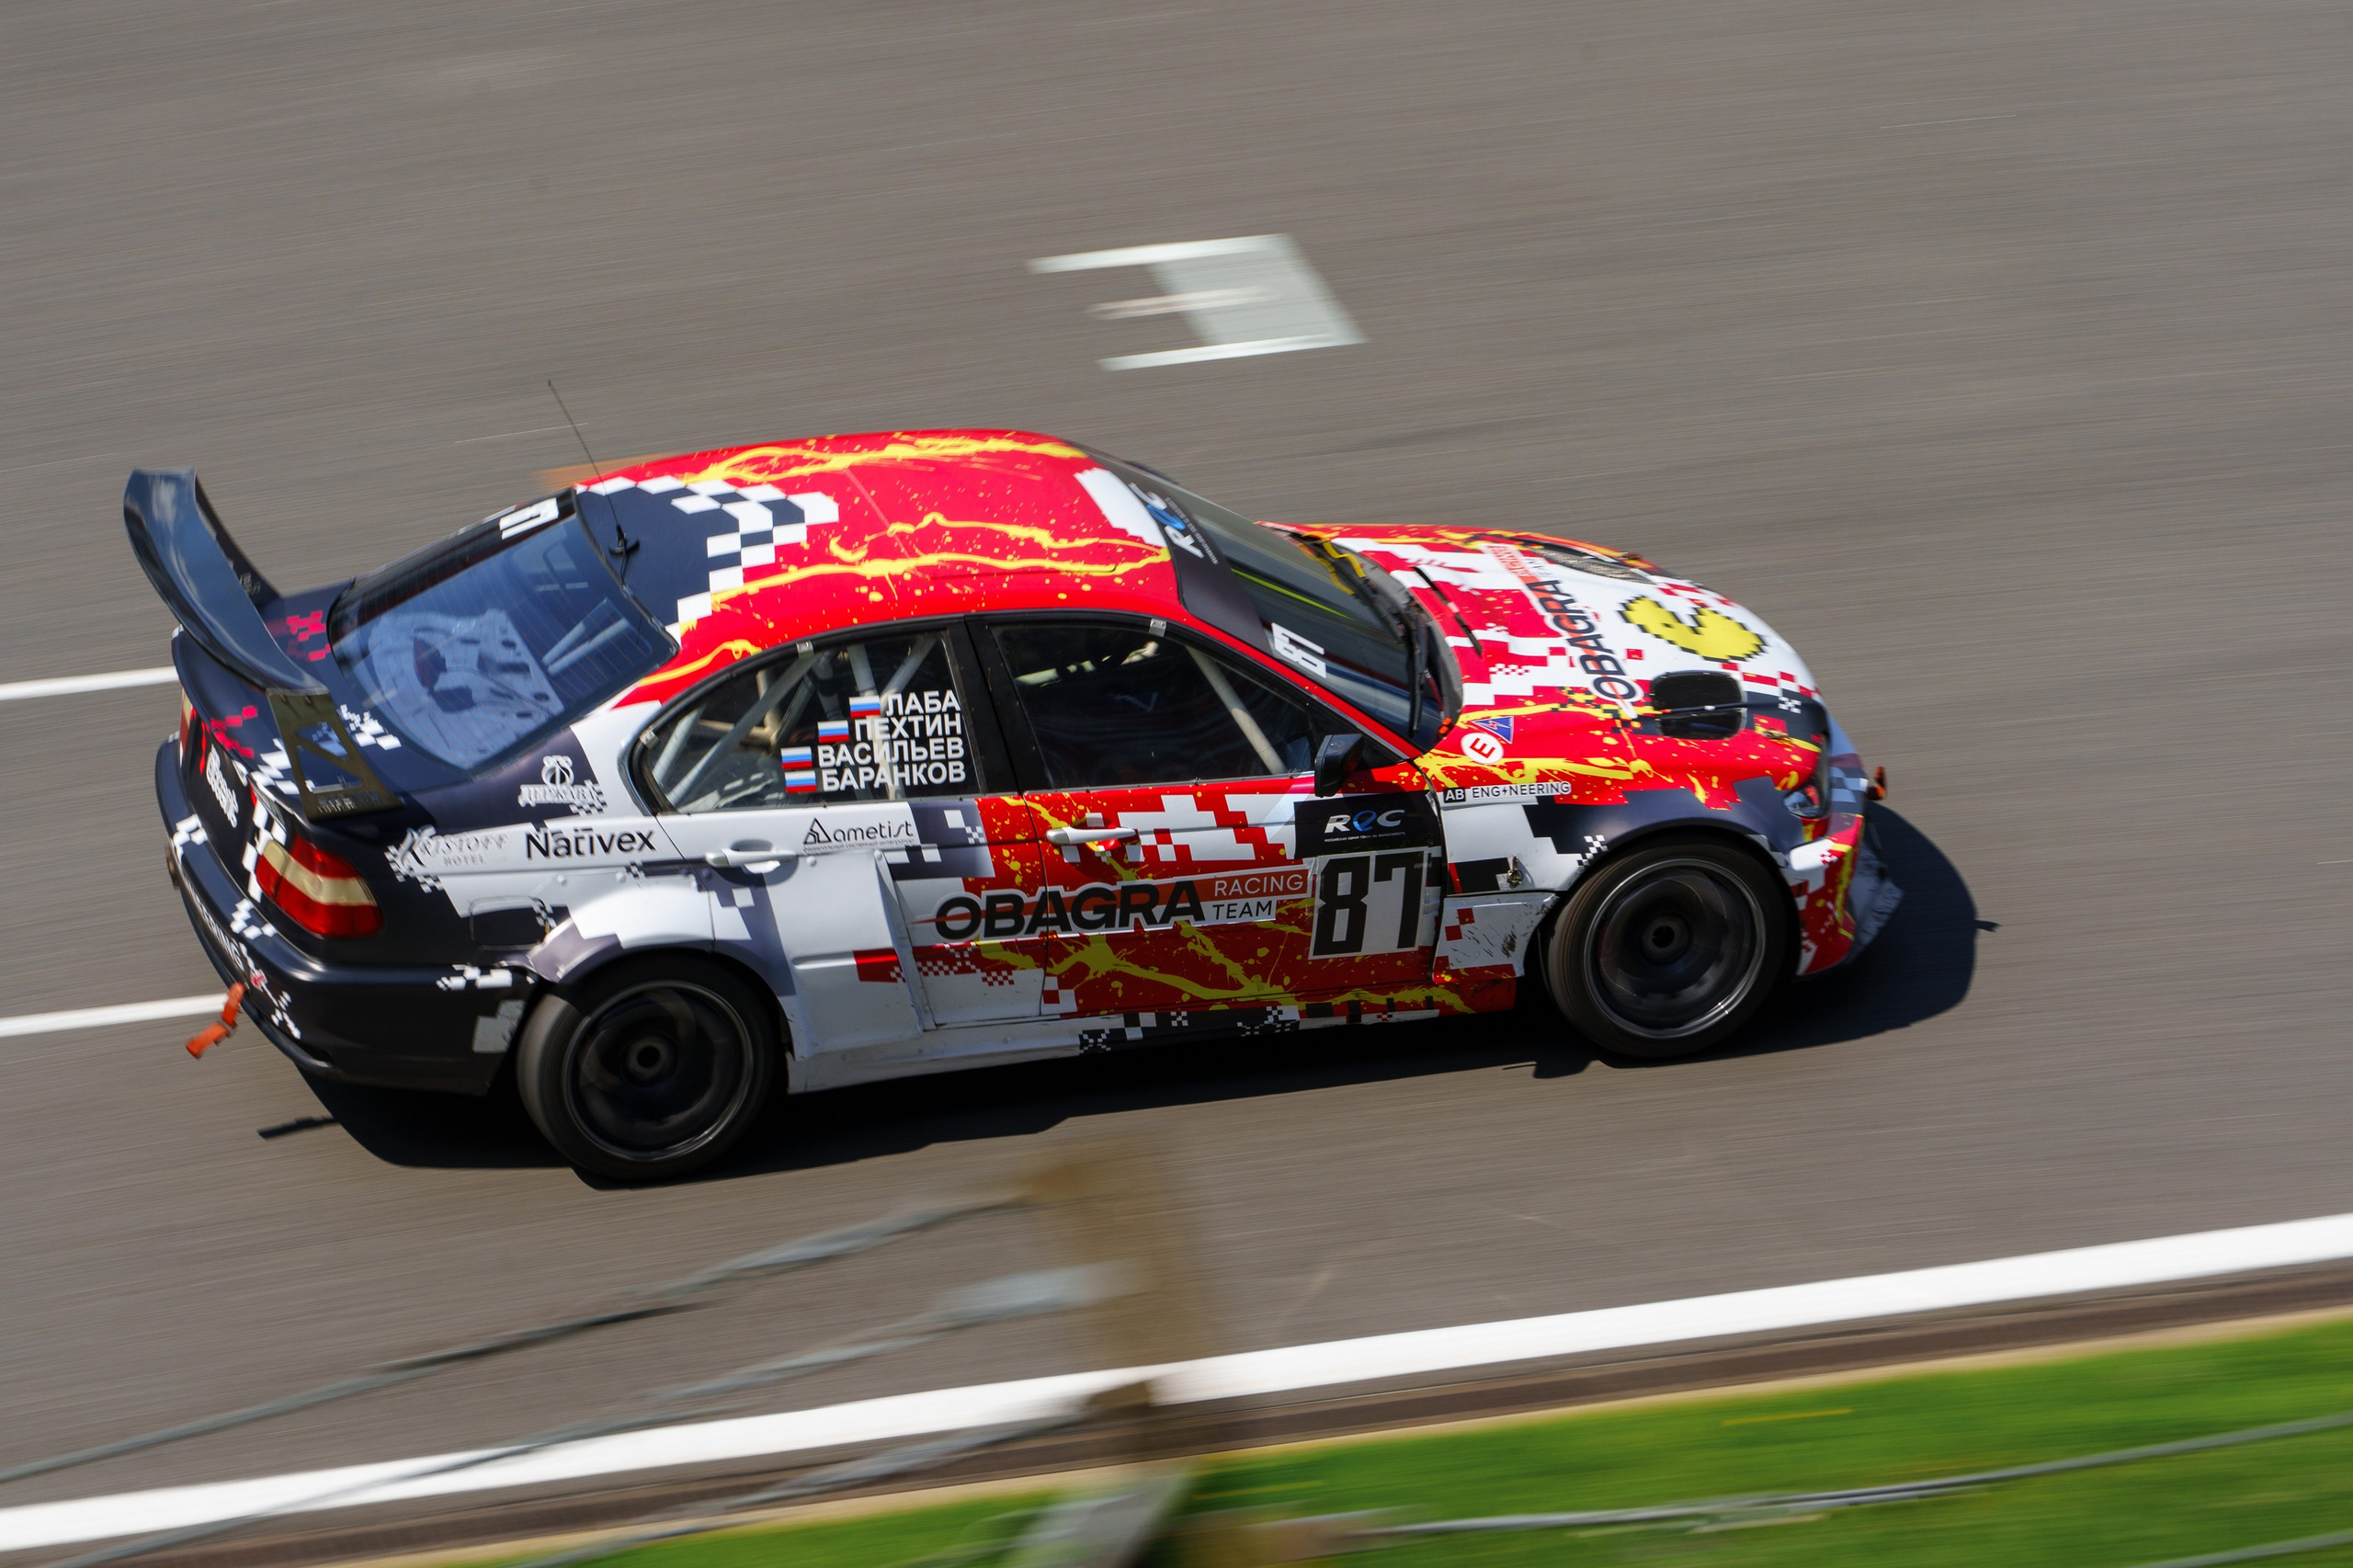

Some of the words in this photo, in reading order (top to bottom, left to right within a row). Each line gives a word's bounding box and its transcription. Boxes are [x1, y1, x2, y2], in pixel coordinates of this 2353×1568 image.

[1526, 580, 1636, 700] OBAGRA
[885, 689, 961, 717] ЛАБА
[854, 712, 962, 742] ПЕХТИН
[817, 736, 965, 768] ВАСИЛЬЕВ
[1469, 737, 1496, 759] E
[821, 760, 966, 792] БАРАНКОВ
[1445, 789, 1465, 801] AB
[525, 827, 659, 859] Nativex
[833, 820, 915, 843] ametist
[934, 880, 1206, 941] OBAGRA
[1213, 873, 1303, 898] RACING
[1212, 899, 1273, 920] TEAM
[1313, 853, 1425, 956] 87
